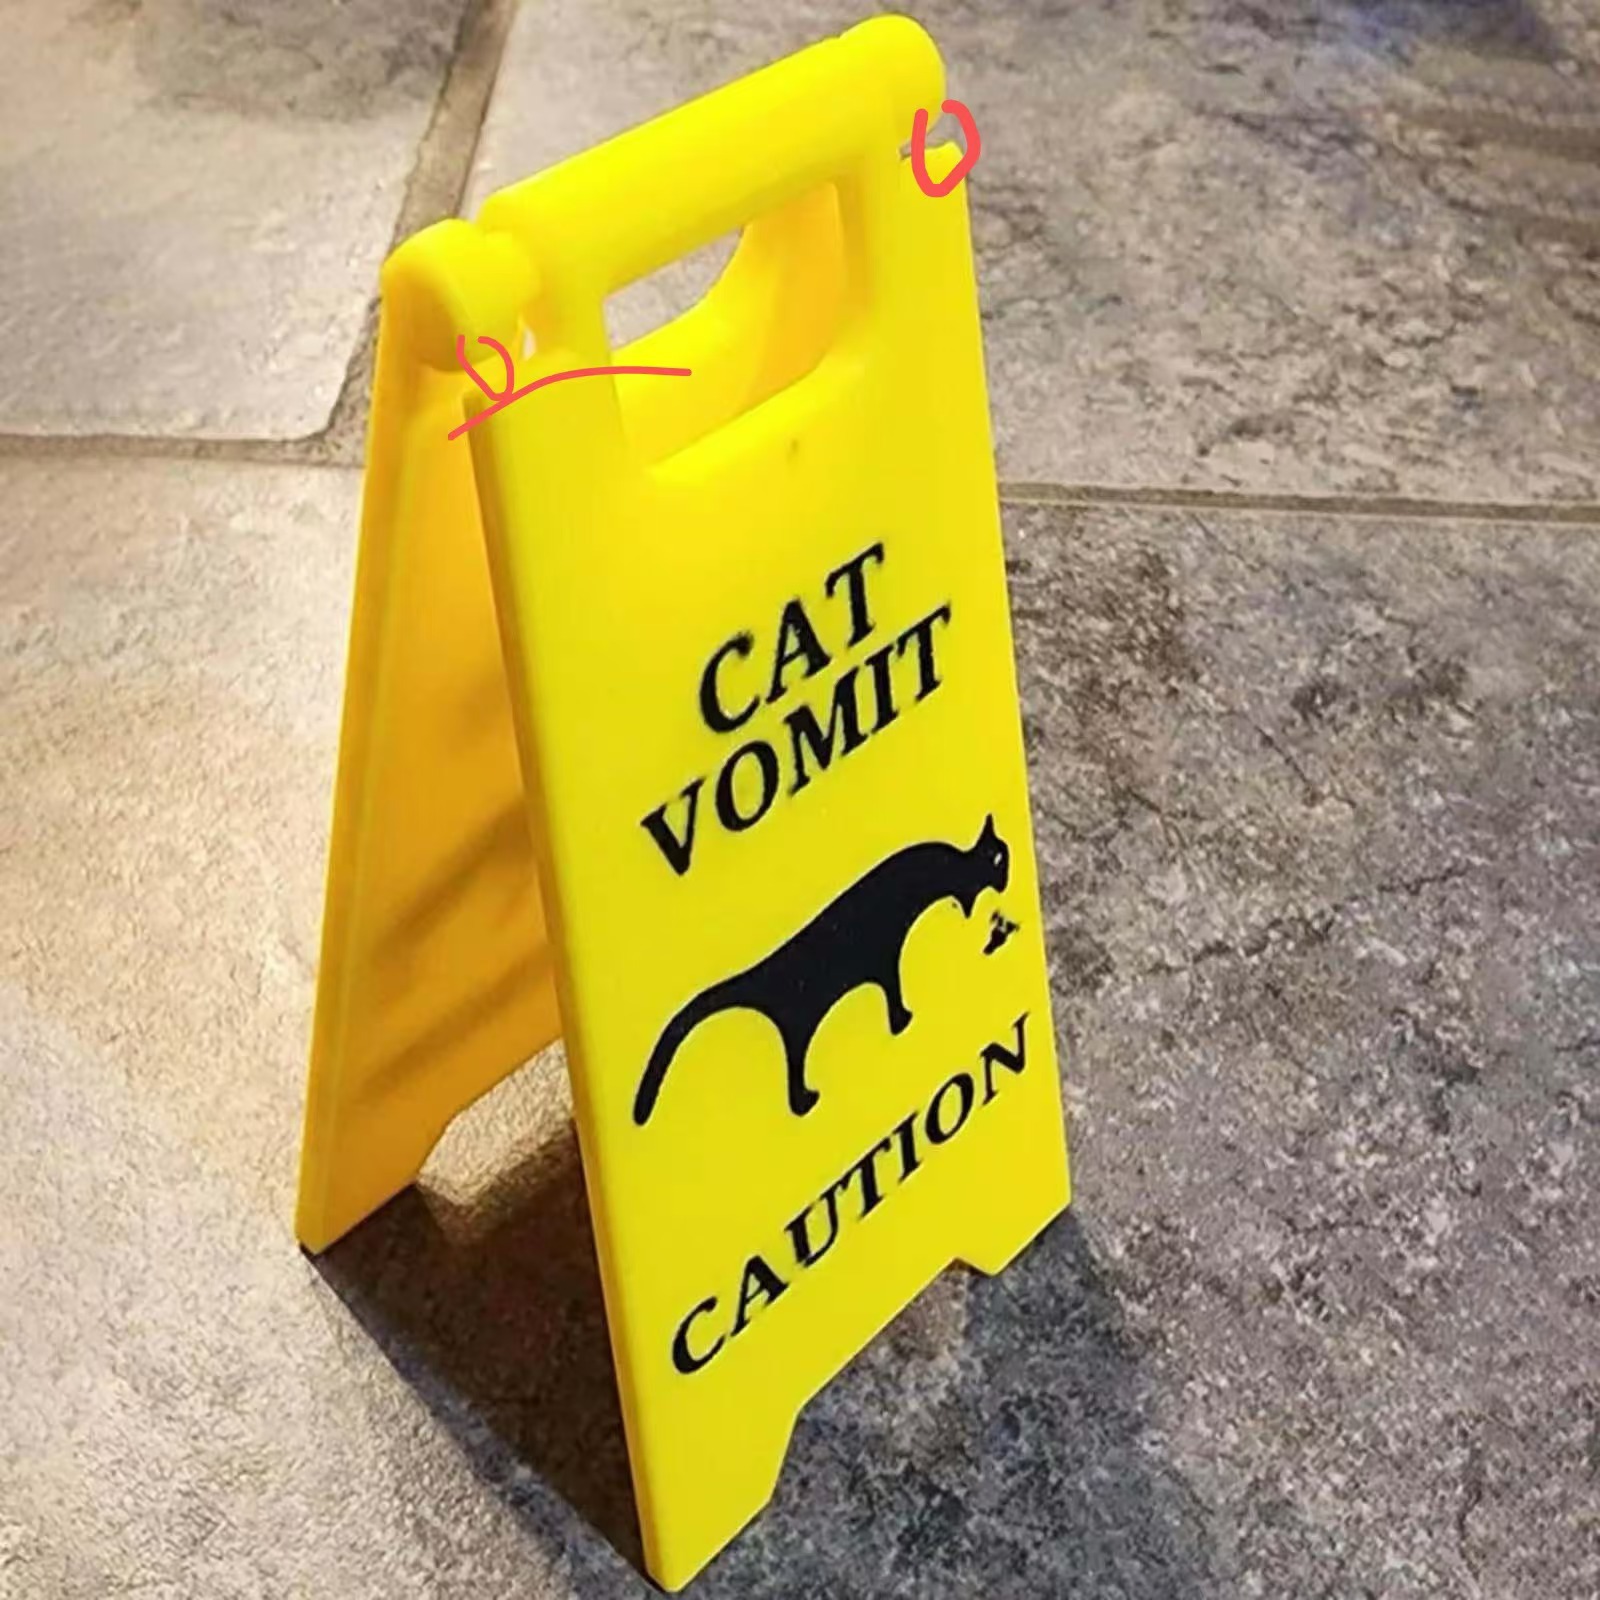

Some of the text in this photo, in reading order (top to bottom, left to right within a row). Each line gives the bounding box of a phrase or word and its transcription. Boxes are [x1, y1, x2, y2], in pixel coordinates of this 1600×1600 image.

[640, 603, 952, 877] VOMIT
[698, 541, 885, 735] CAT
[671, 1012, 1031, 1376] CAUTION
